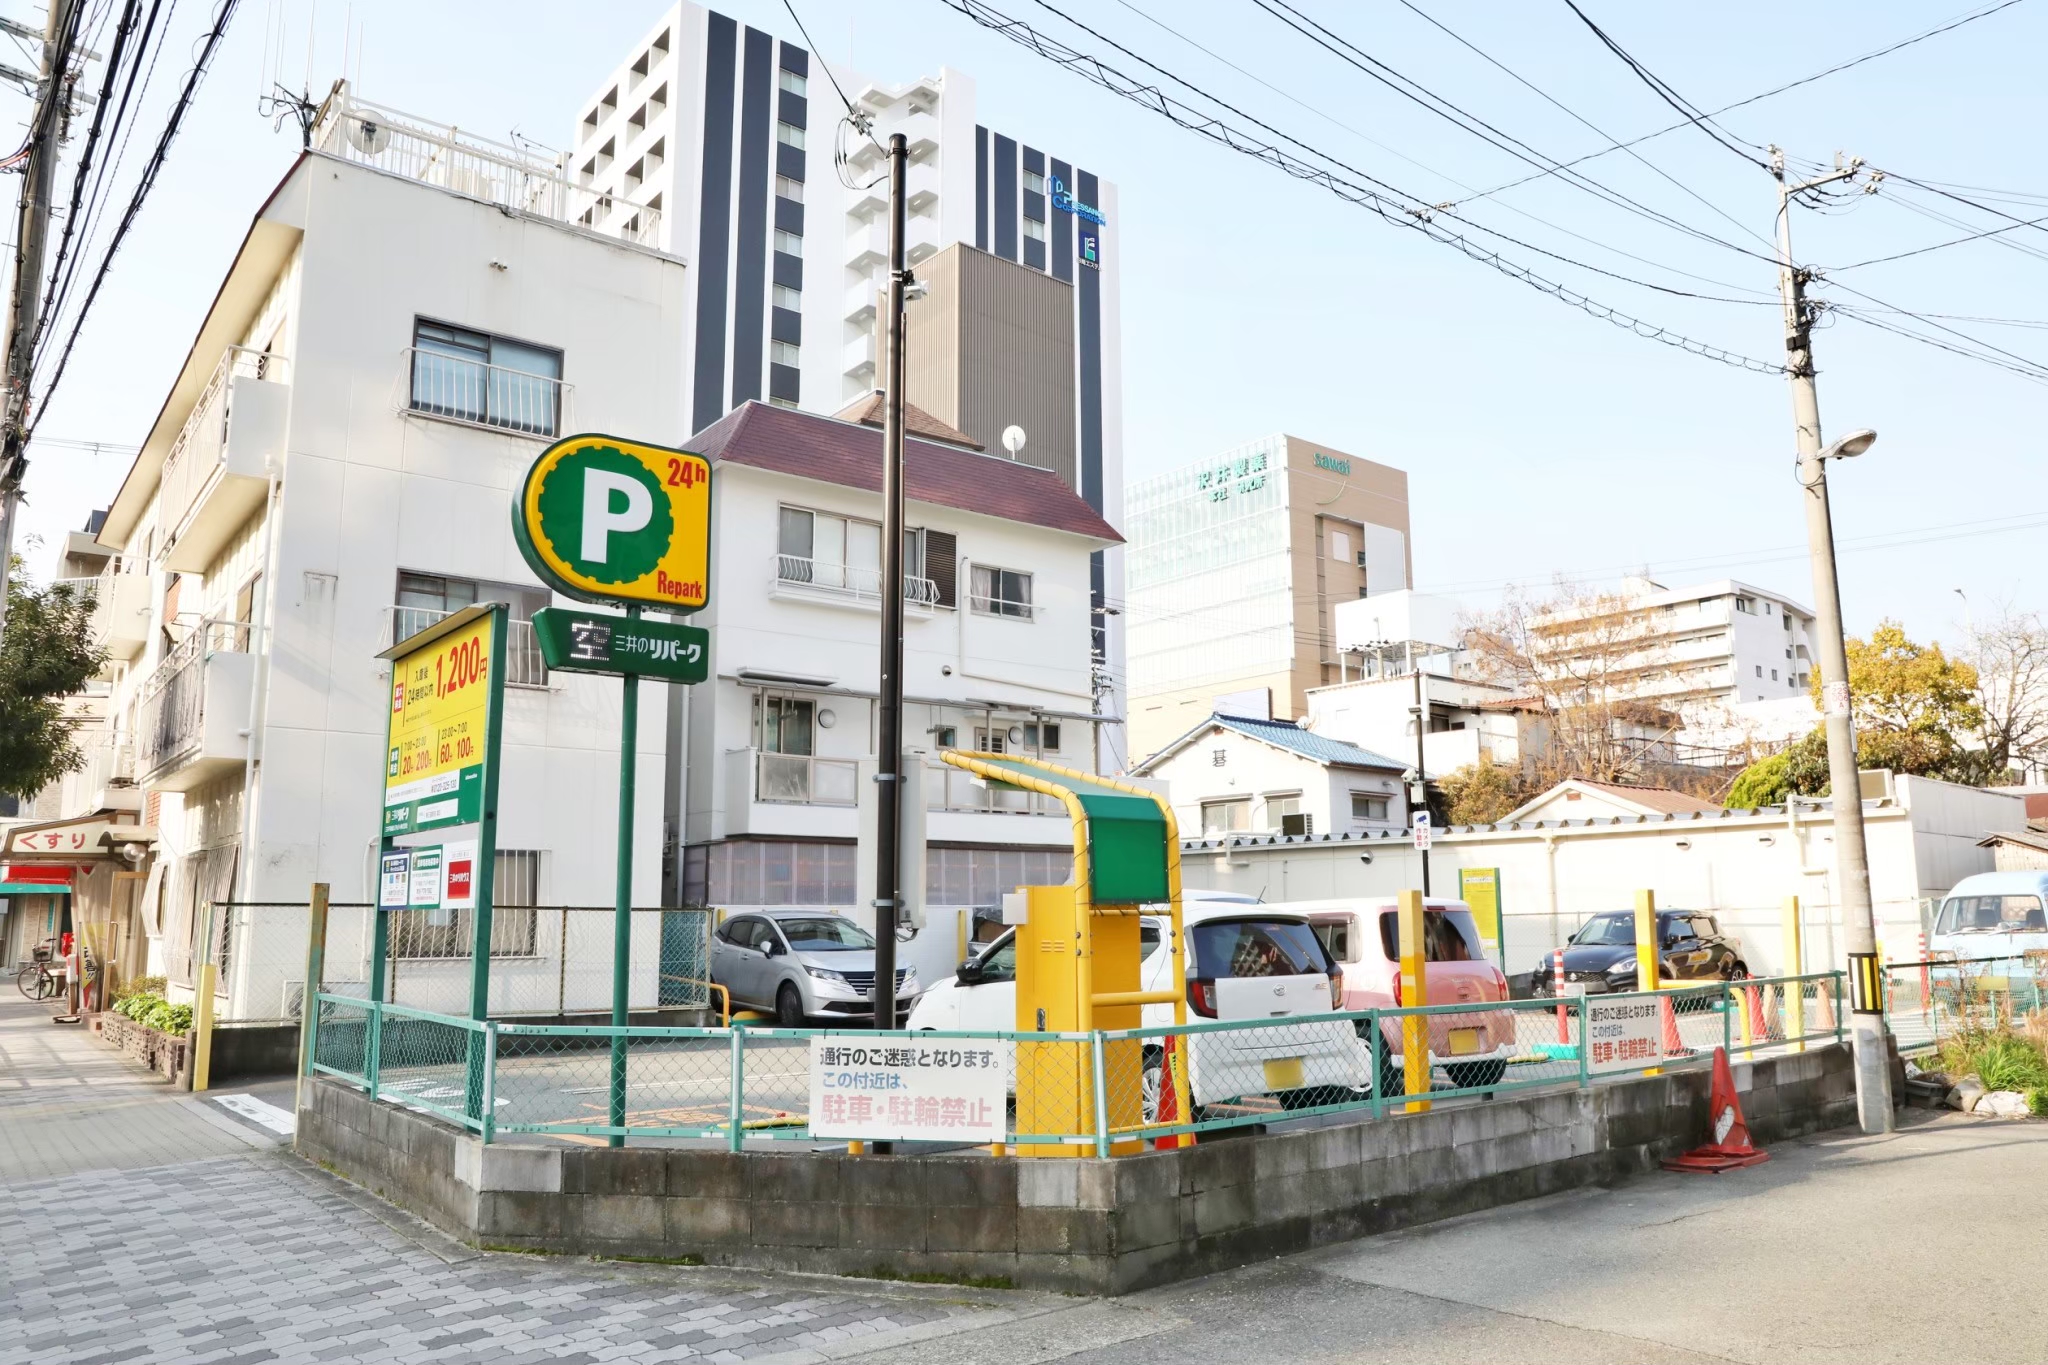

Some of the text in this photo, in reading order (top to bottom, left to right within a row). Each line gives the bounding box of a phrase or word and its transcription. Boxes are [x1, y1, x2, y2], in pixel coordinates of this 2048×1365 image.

[668, 458, 706, 489] 24h
[1313, 452, 1351, 477] sawai
[580, 466, 653, 564] P
[657, 570, 703, 599] Repark
[19, 832, 86, 850] くすり
[819, 1047, 999, 1069] 通行のご迷惑となります。
[1592, 1037, 1657, 1064] 駐車・駐輪禁止
[822, 1071, 909, 1090] この付近は、
[820, 1093, 993, 1128] 駐車・駐輪禁止
